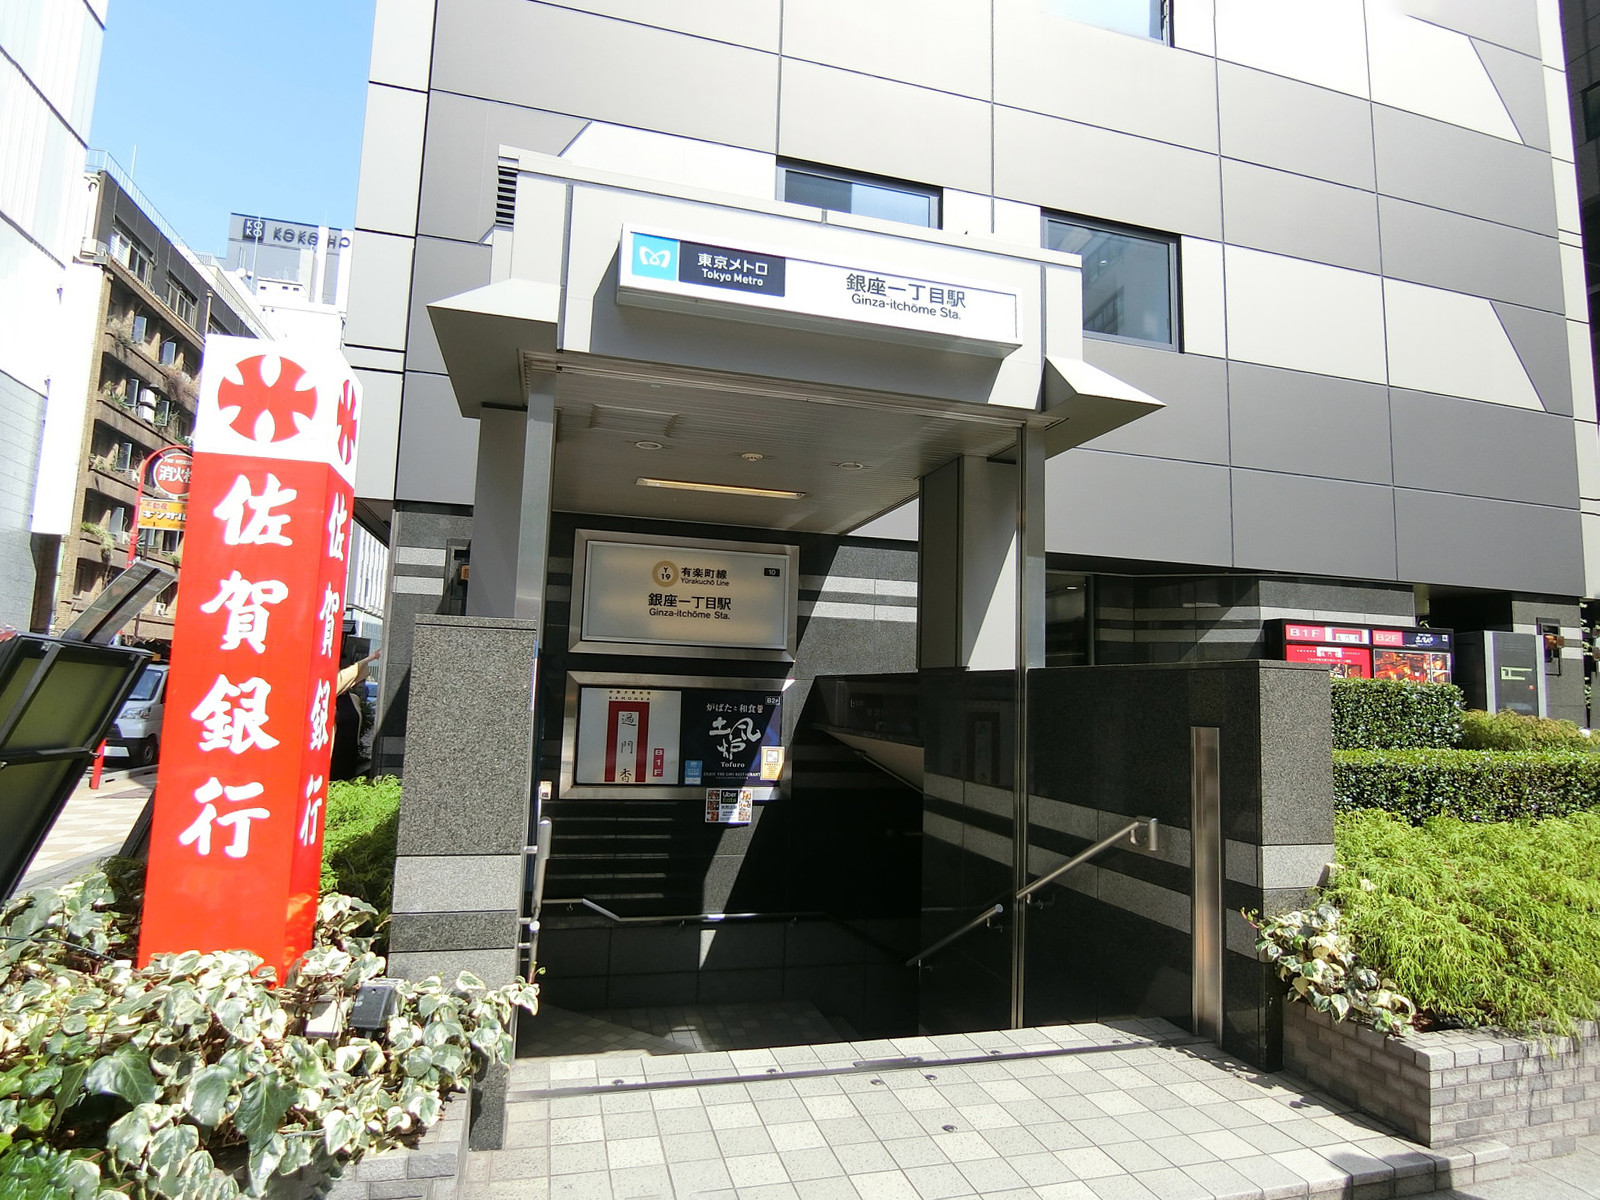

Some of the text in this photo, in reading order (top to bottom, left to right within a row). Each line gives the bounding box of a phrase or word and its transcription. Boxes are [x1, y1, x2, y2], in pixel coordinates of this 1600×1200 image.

[697, 252, 768, 276] 東京メトロ
[701, 268, 764, 287] Tokyo Metro
[846, 273, 966, 308] 銀座一丁目駅
[851, 293, 961, 321] Ginza-itchōme Sta.
[681, 567, 727, 580] 有楽町線
[681, 577, 730, 587] Yūrakuchō Line
[648, 593, 732, 610] 銀座一丁目駅
[649, 608, 730, 620] Ginza-itchōme Sta.
[1289, 627, 1320, 638] B1F
[1375, 633, 1399, 643] B2F
[178, 473, 298, 858] 佐賀銀行
[299, 492, 350, 847] 佐賀銀行
[653, 749, 663, 776] B1F
